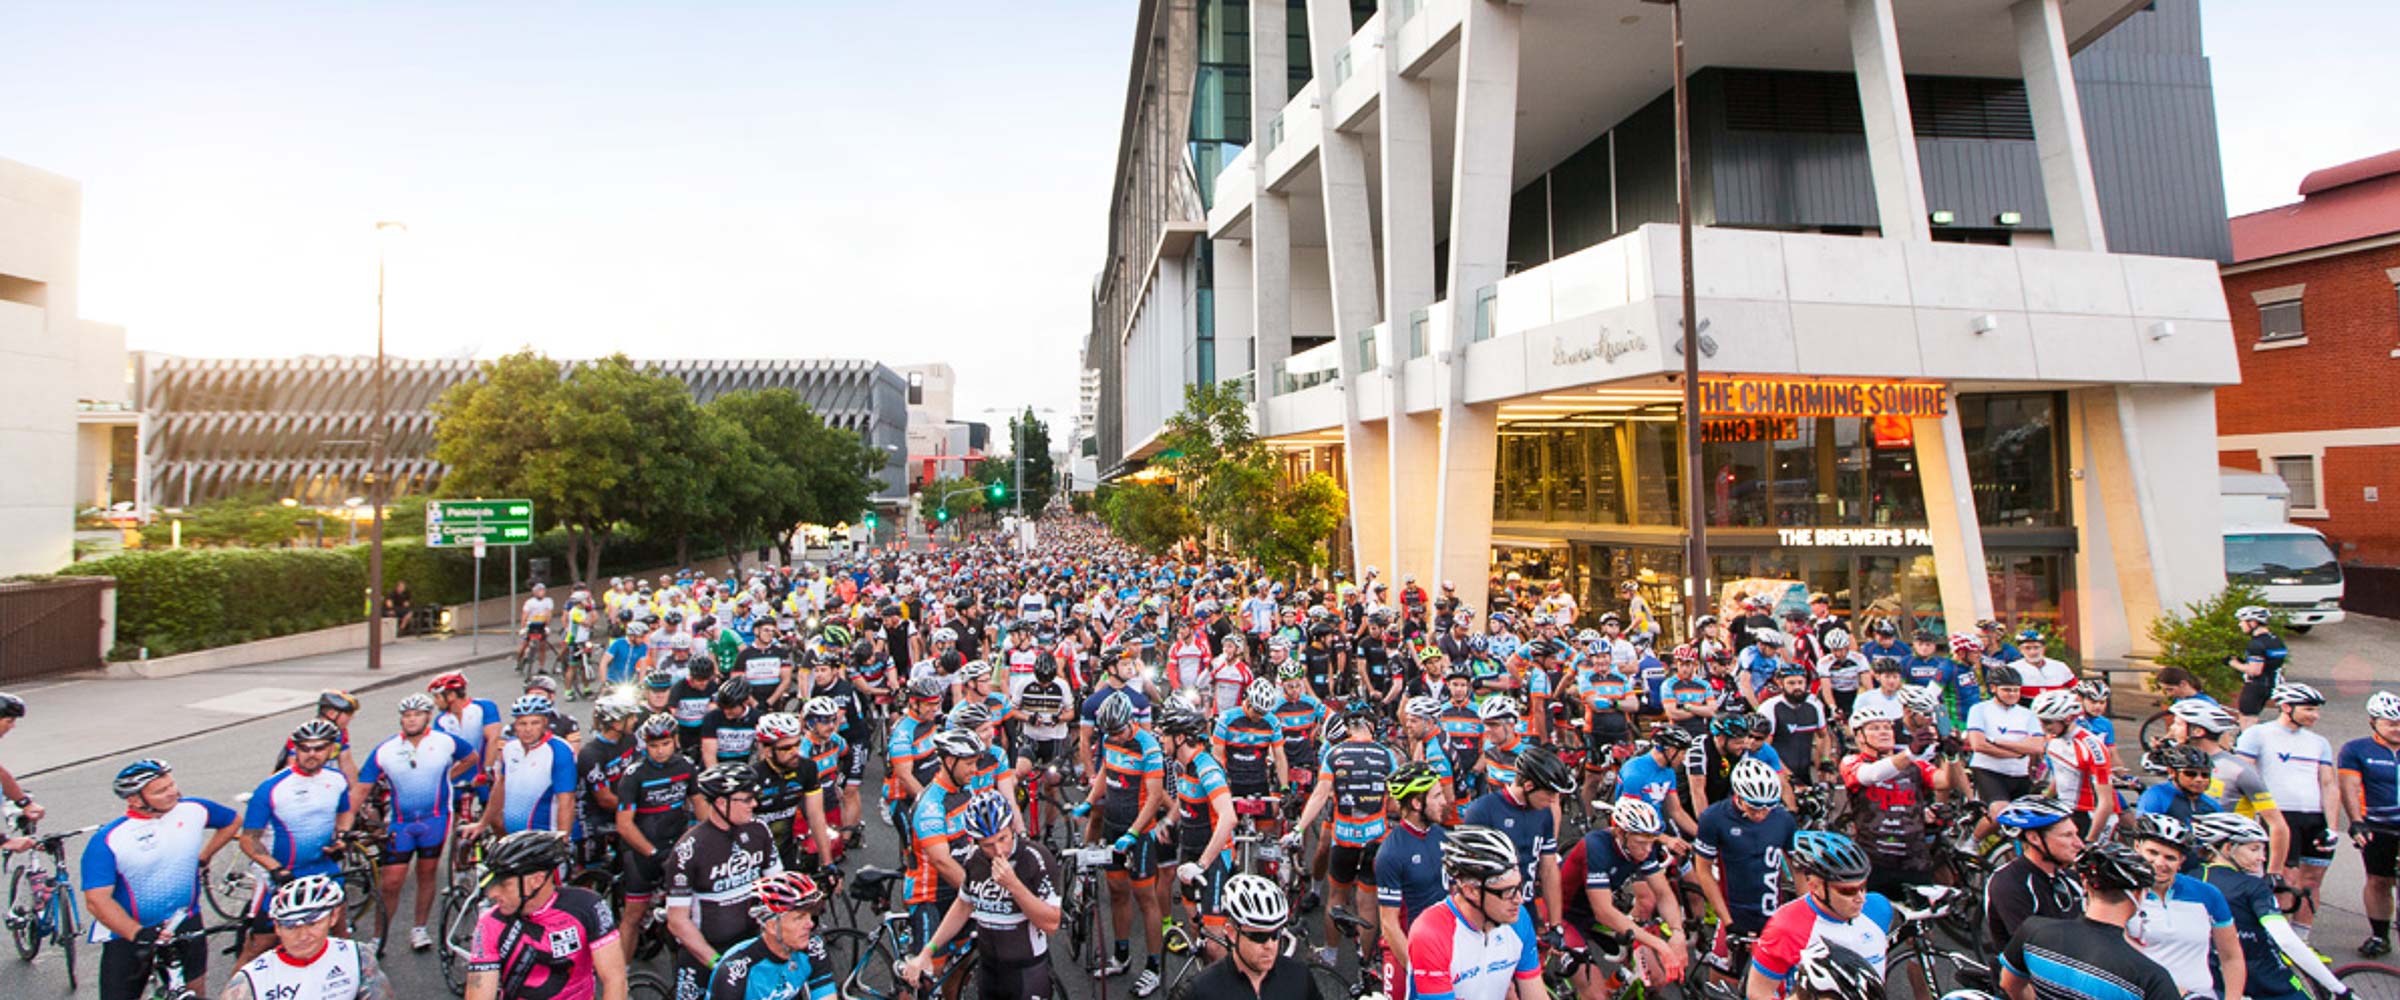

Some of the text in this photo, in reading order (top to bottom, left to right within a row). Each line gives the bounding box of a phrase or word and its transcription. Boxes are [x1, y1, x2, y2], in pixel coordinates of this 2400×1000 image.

[1740, 382, 1864, 415] CHARMING
[1868, 385, 1948, 415] SQUIRE
[1778, 528, 1813, 546] THE
[1815, 528, 1903, 546] BREWER'S
